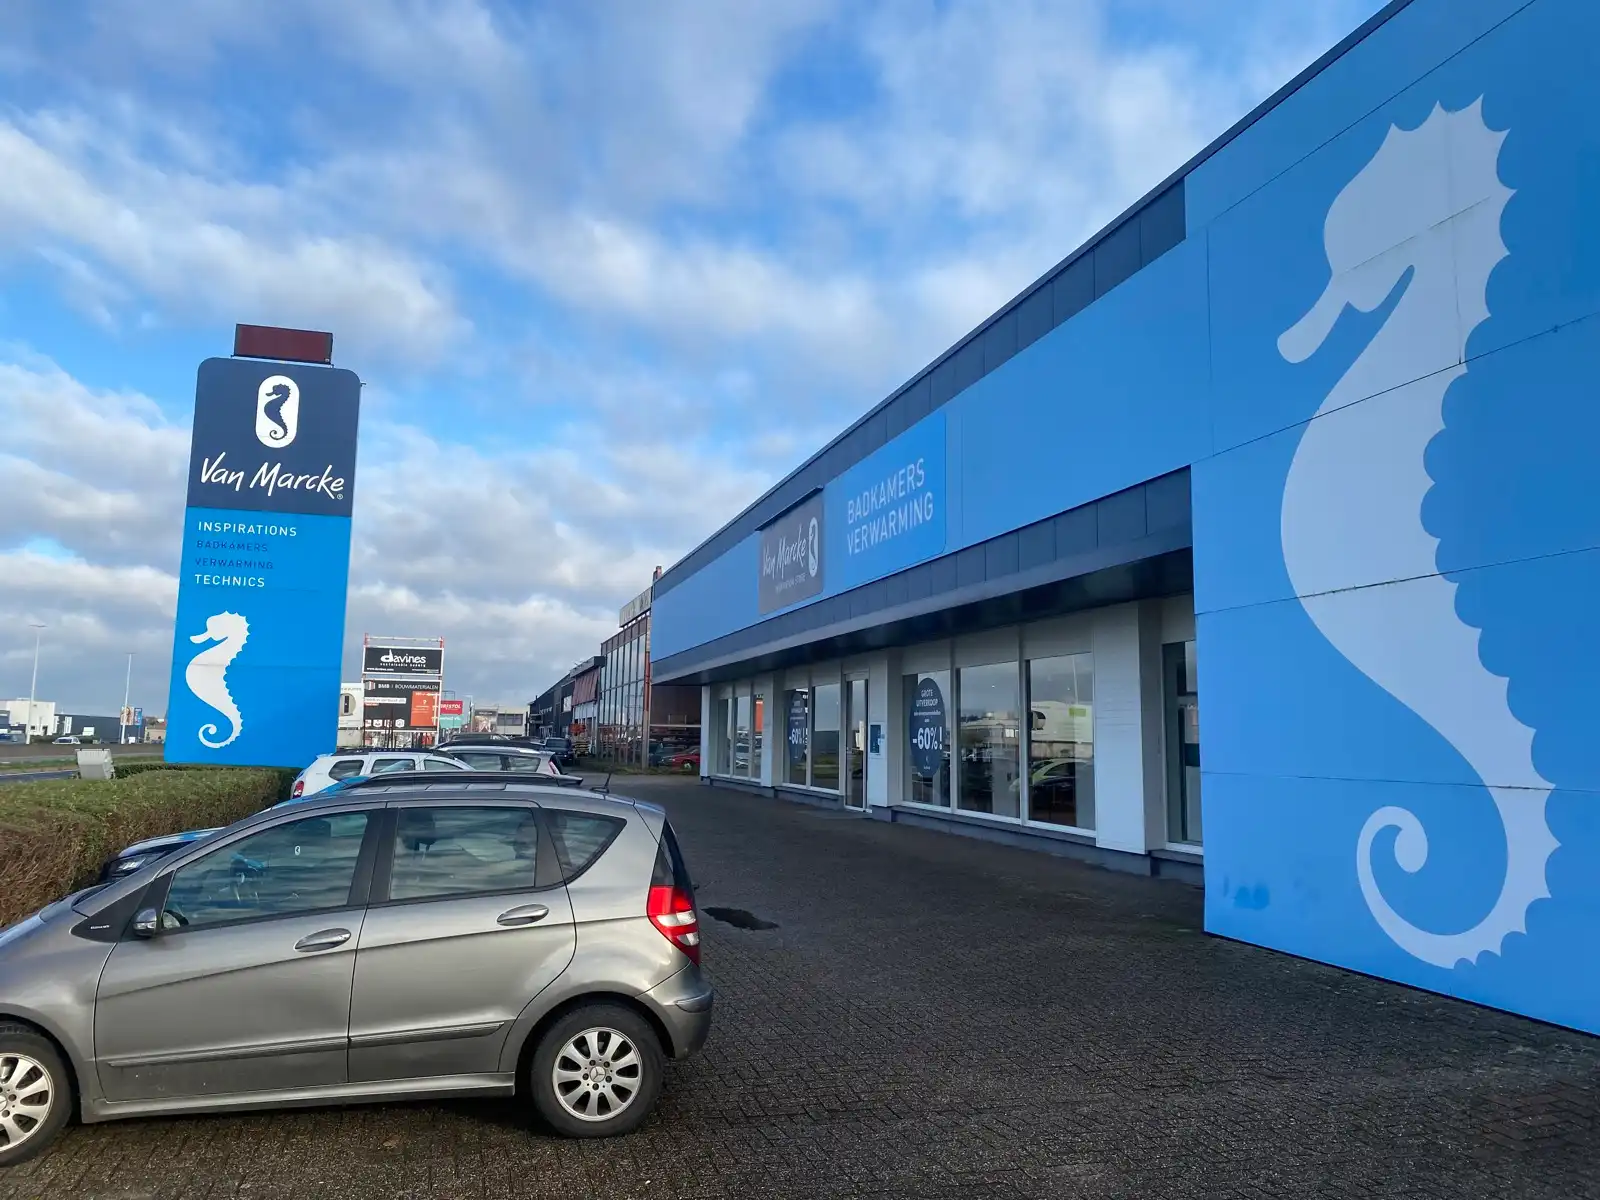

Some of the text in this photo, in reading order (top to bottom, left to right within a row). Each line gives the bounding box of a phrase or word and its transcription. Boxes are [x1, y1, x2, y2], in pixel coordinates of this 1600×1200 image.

[200, 452, 344, 499] Van Marcke
[847, 457, 926, 525] BADKAMERS
[198, 521, 298, 537] INSPIRATIONS
[846, 491, 934, 556] VERWARMING
[196, 540, 268, 552] BADKAMERS
[762, 523, 807, 580] Van Marcke
[194, 557, 275, 570] VERWARMING
[194, 574, 266, 588] TECHNICS
[380, 648, 427, 664] davines
